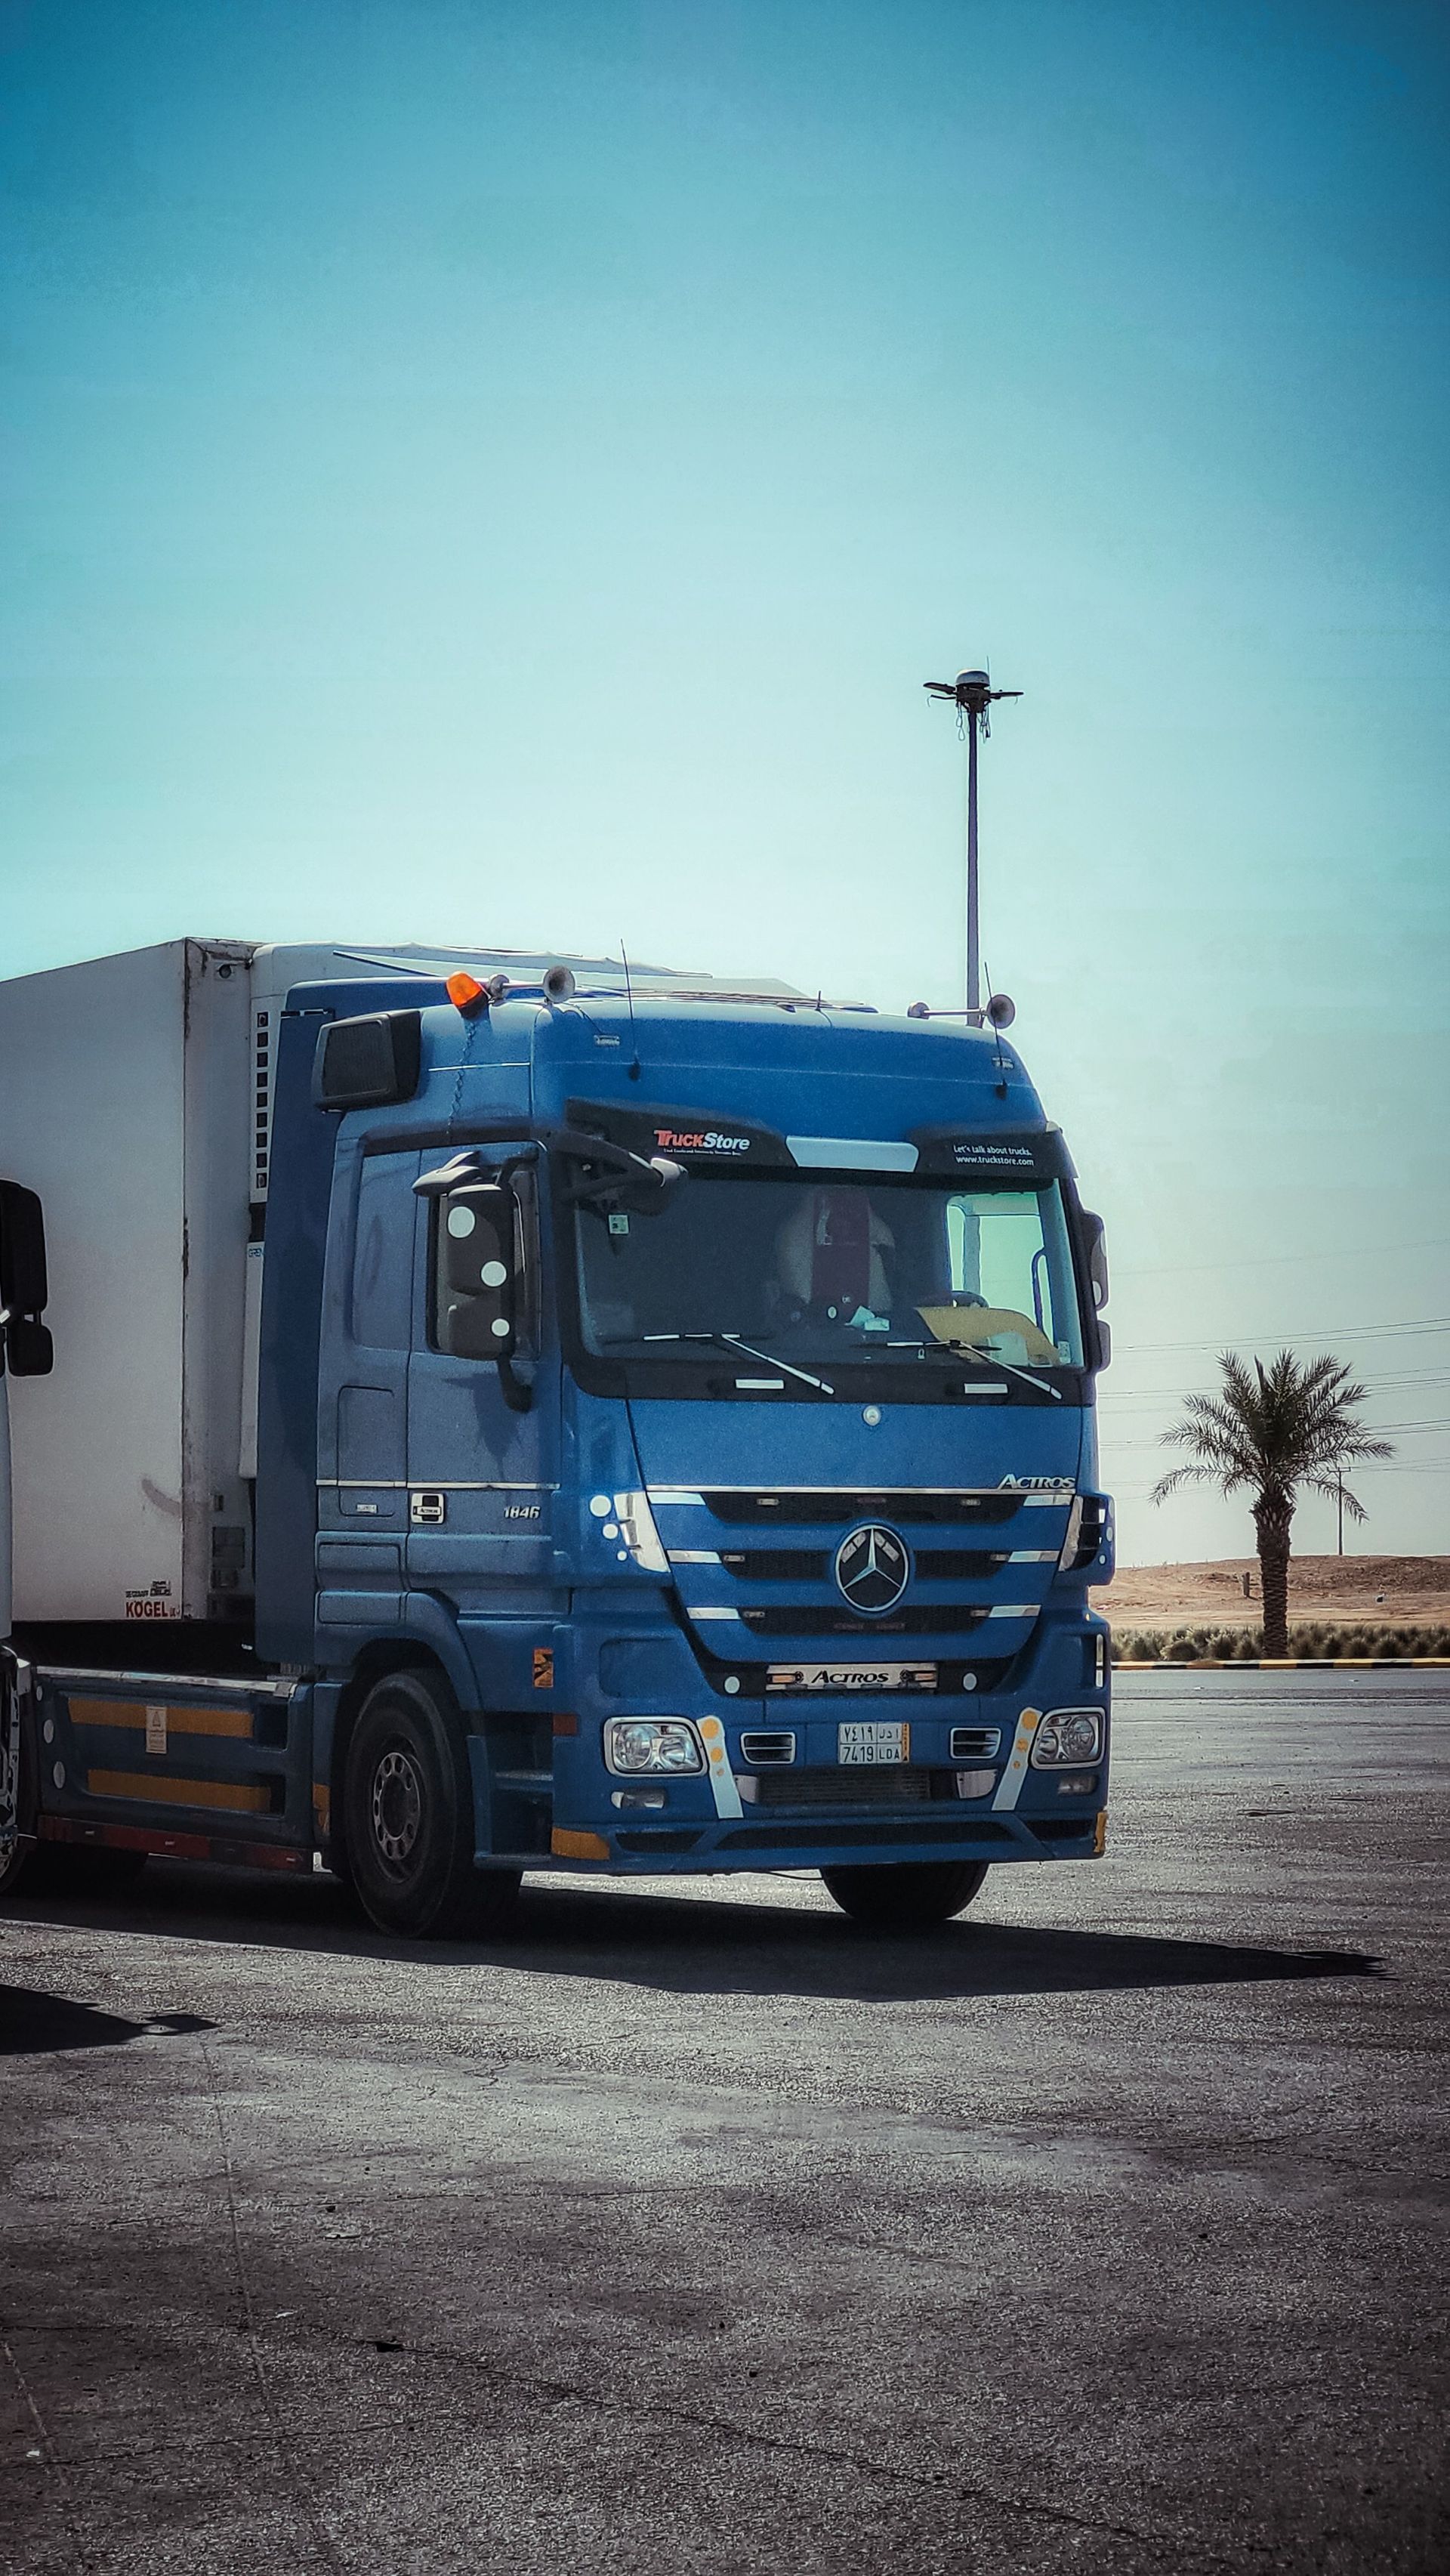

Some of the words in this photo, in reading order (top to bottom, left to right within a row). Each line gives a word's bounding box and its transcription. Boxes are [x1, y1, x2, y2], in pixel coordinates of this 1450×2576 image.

[971, 1145, 986, 1154] talk
[986, 1146, 1008, 1155] about
[955, 1156, 1035, 1166] www.truckstore.com
[998, 1473, 1076, 1489] ACTROS
[503, 1506, 541, 1519] 1846
[125, 1600, 168, 1617] KÖGEL
[811, 1670, 890, 1684] ACTROS
[843, 1746, 874, 1762] 7419
[879, 1748, 900, 1759] LDA
